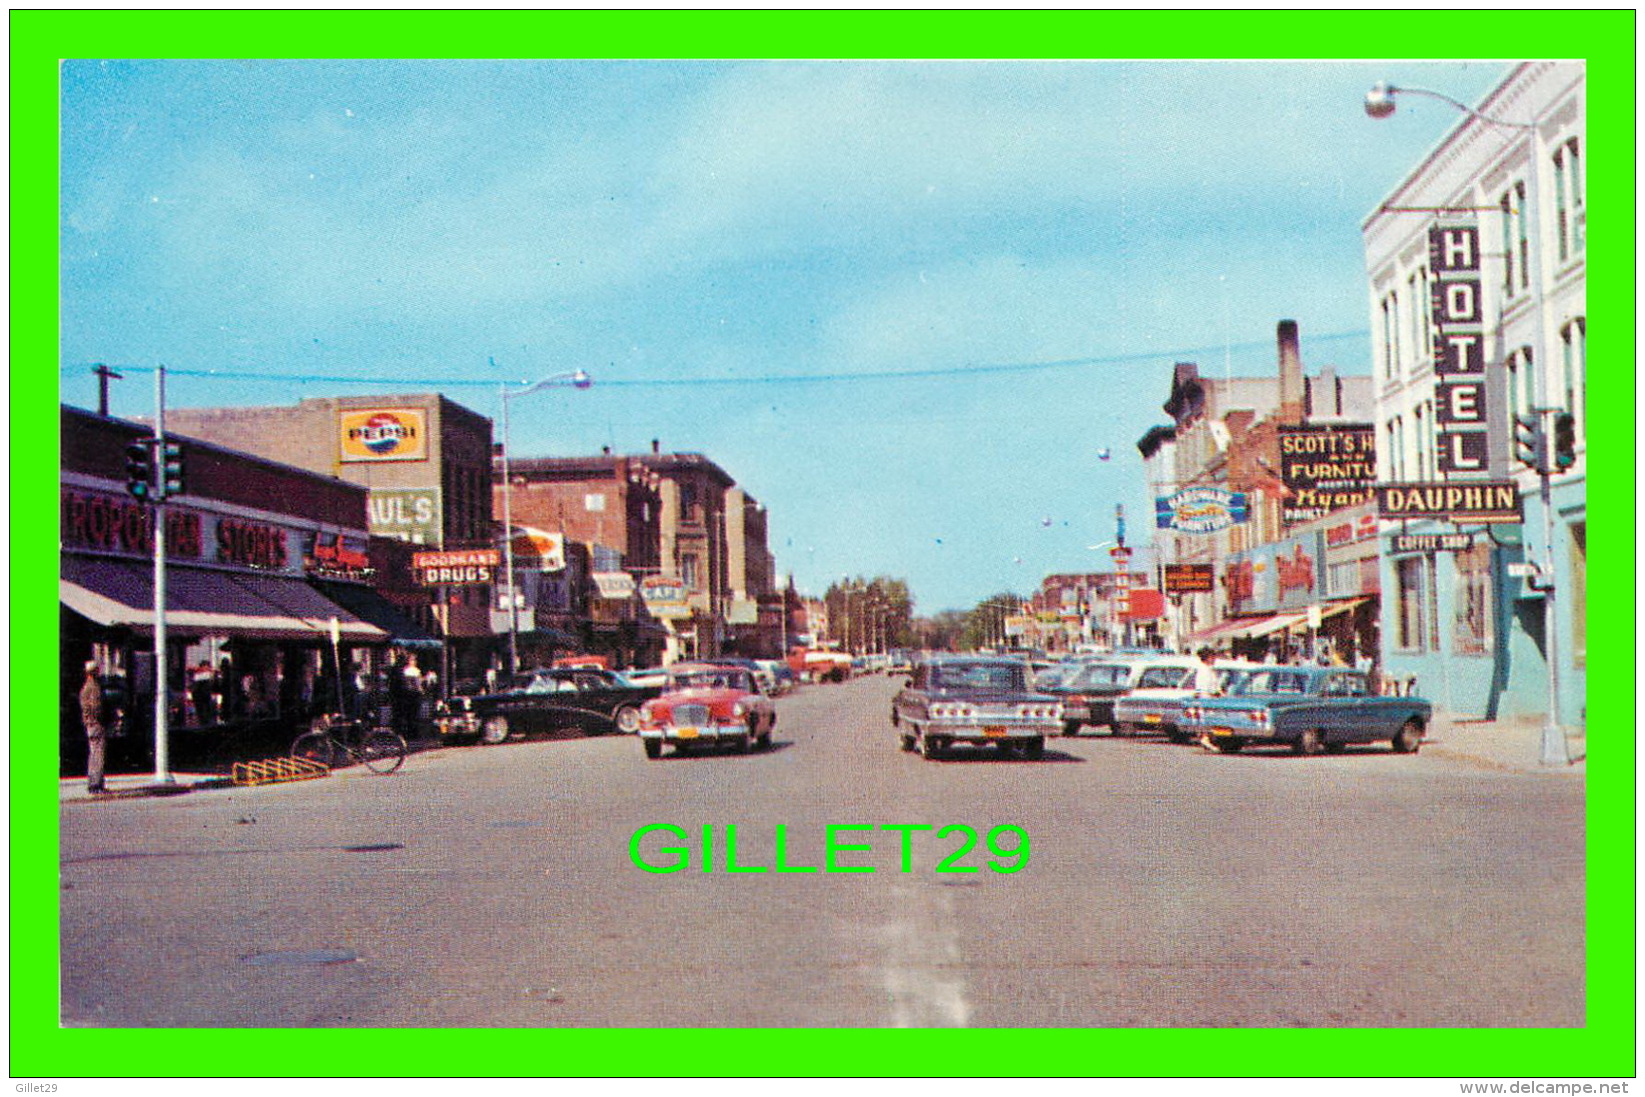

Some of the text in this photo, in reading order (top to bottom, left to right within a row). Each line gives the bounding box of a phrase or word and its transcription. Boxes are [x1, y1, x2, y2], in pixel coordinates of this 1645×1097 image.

[1444, 230, 1480, 468] HOTEL
[348, 426, 416, 440] PEPSI
[1283, 433, 1355, 453] SCOTT'S
[1290, 462, 1376, 478] FURNITU
[1386, 486, 1514, 511] DAUPHIN
[1398, 535, 1436, 550] COFFEE
[426, 566, 490, 582] DRUGS
